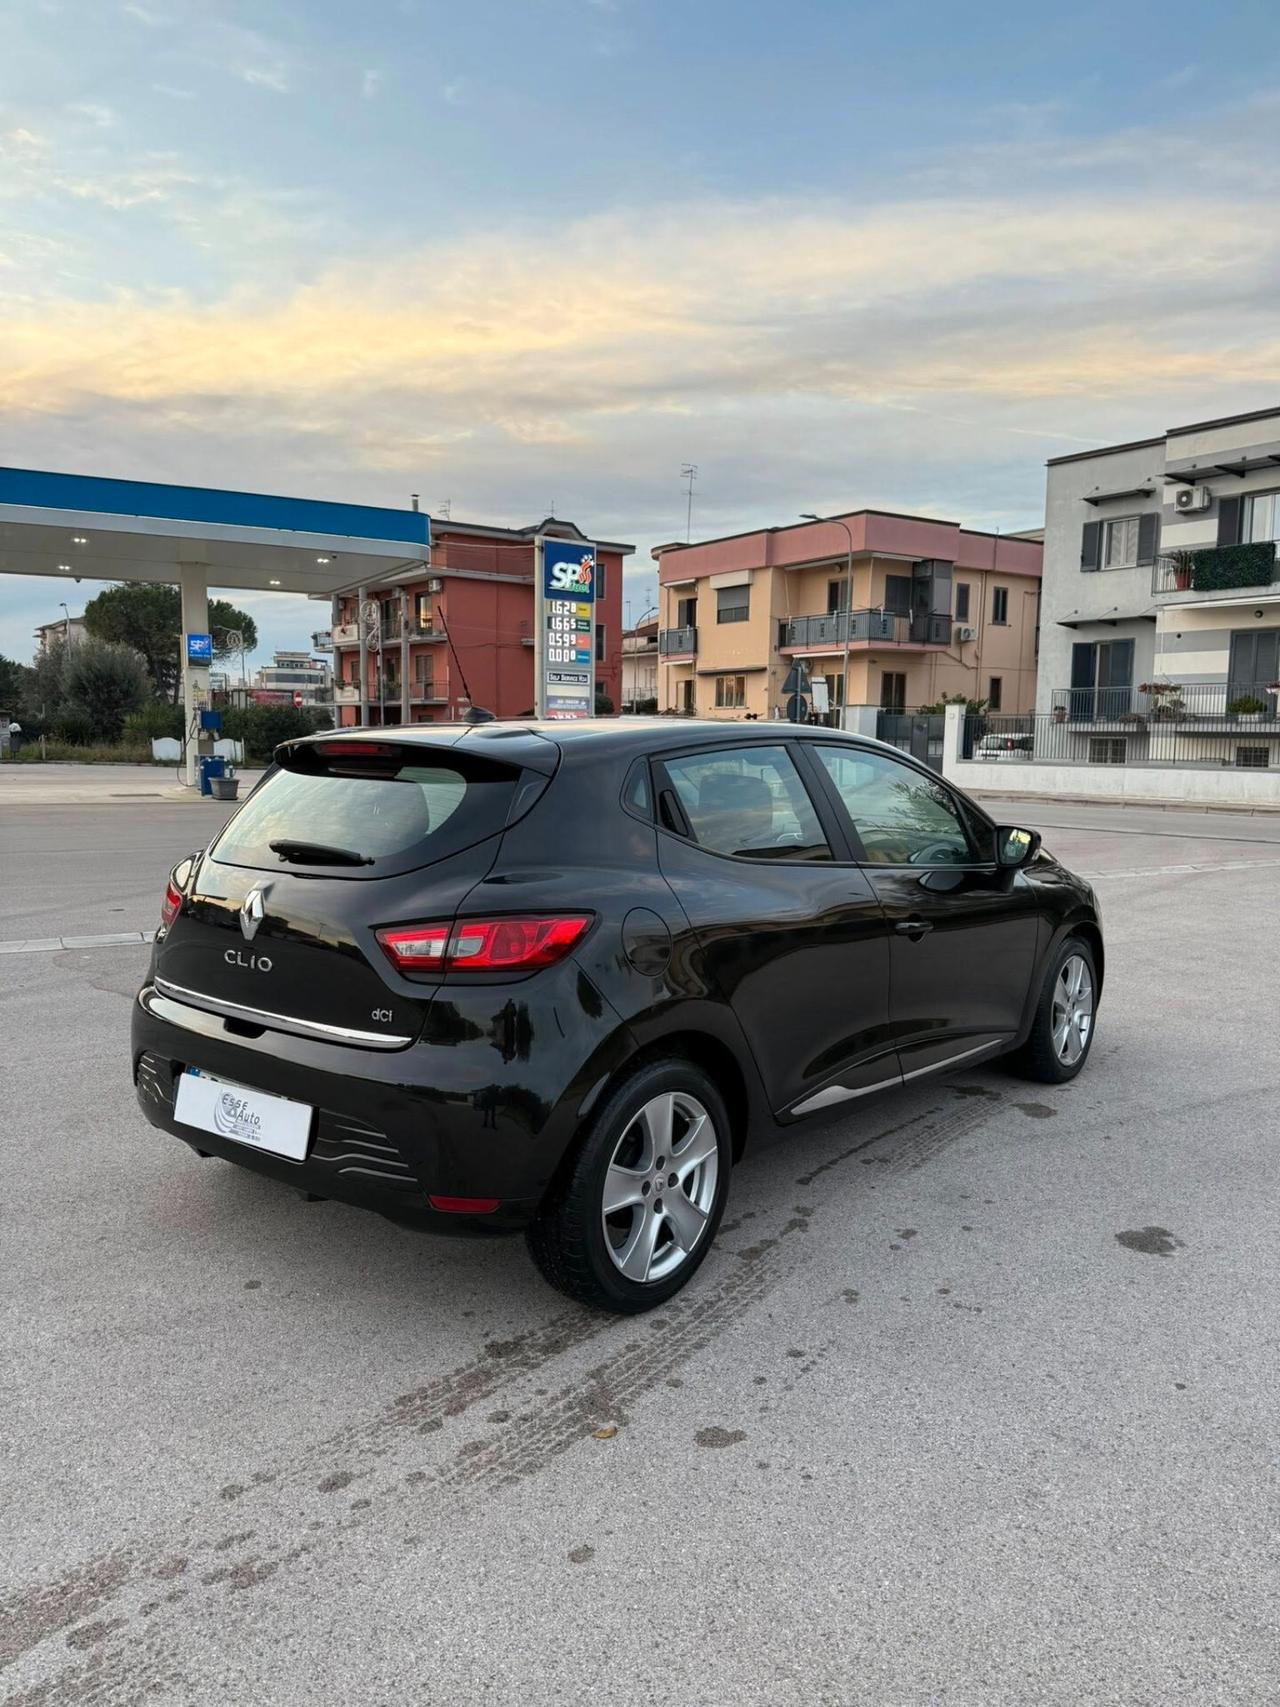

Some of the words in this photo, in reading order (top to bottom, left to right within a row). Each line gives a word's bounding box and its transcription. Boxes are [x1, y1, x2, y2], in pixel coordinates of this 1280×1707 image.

[224, 949, 273, 972] CLIO
[371, 1008, 393, 1022] dCi
[236, 1109, 260, 1125] Auto
